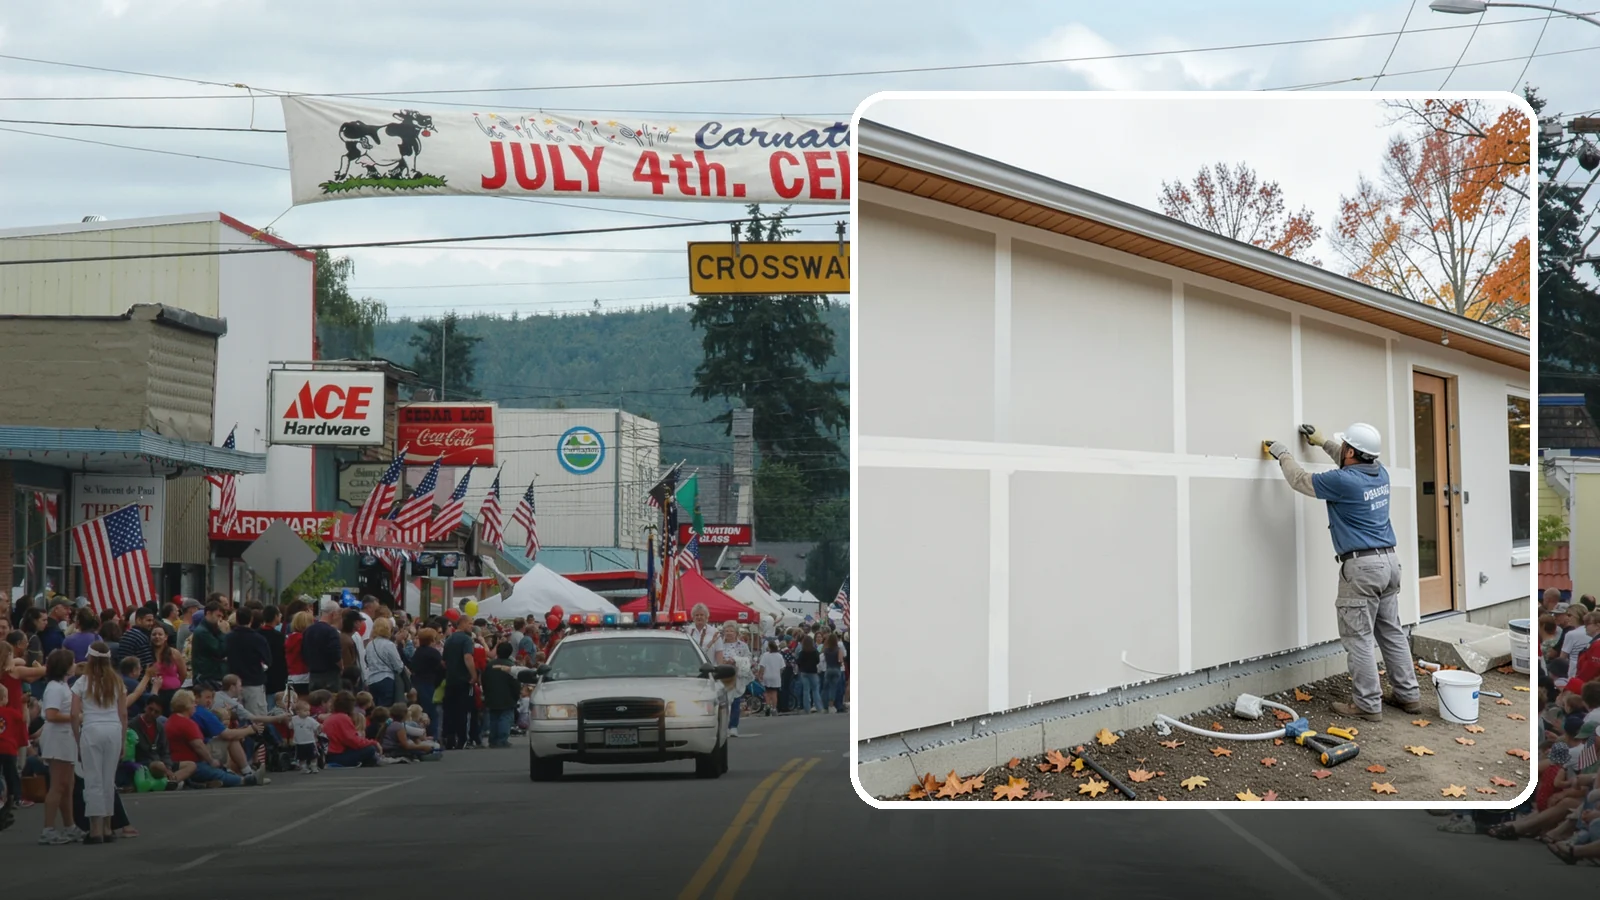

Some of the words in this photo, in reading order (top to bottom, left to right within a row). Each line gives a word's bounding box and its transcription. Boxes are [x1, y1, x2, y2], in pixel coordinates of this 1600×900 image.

[481, 141, 605, 193] JULY
[632, 150, 746, 198] 4th.
[697, 254, 850, 280] CROSSWA
[283, 380, 373, 420] ACE
[405, 409, 453, 422] CEDAR
[283, 421, 371, 436] Hardware
[416, 428, 477, 447] Coca-Cola
[353, 467, 384, 480] Simpl
[83, 484, 93, 494] St.
[95, 484, 124, 495] Vincent
[126, 485, 136, 495] de
[137, 485, 156, 495] Paul
[212, 515, 331, 536] HARDARE
[688, 526, 741, 535] CRNATION
[699, 535, 730, 543] GLASS
